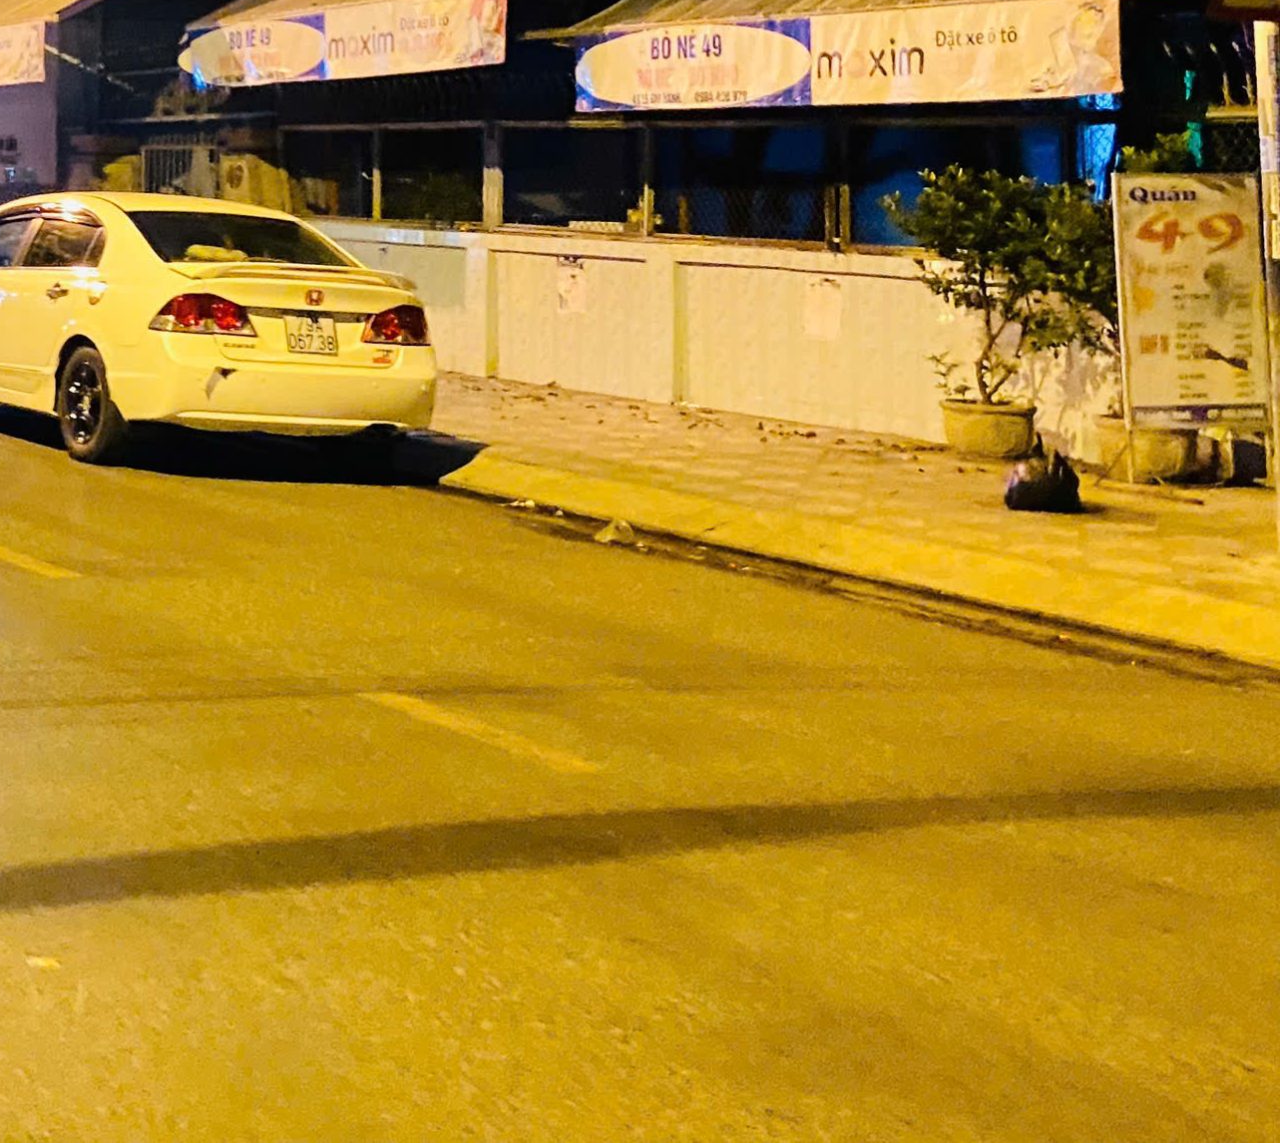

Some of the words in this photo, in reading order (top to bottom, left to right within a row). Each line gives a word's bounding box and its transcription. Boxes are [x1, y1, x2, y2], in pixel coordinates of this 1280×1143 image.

[702, 34, 721, 58] 49
[817, 37, 925, 79] mxim
[1136, 210, 1244, 254] 49
